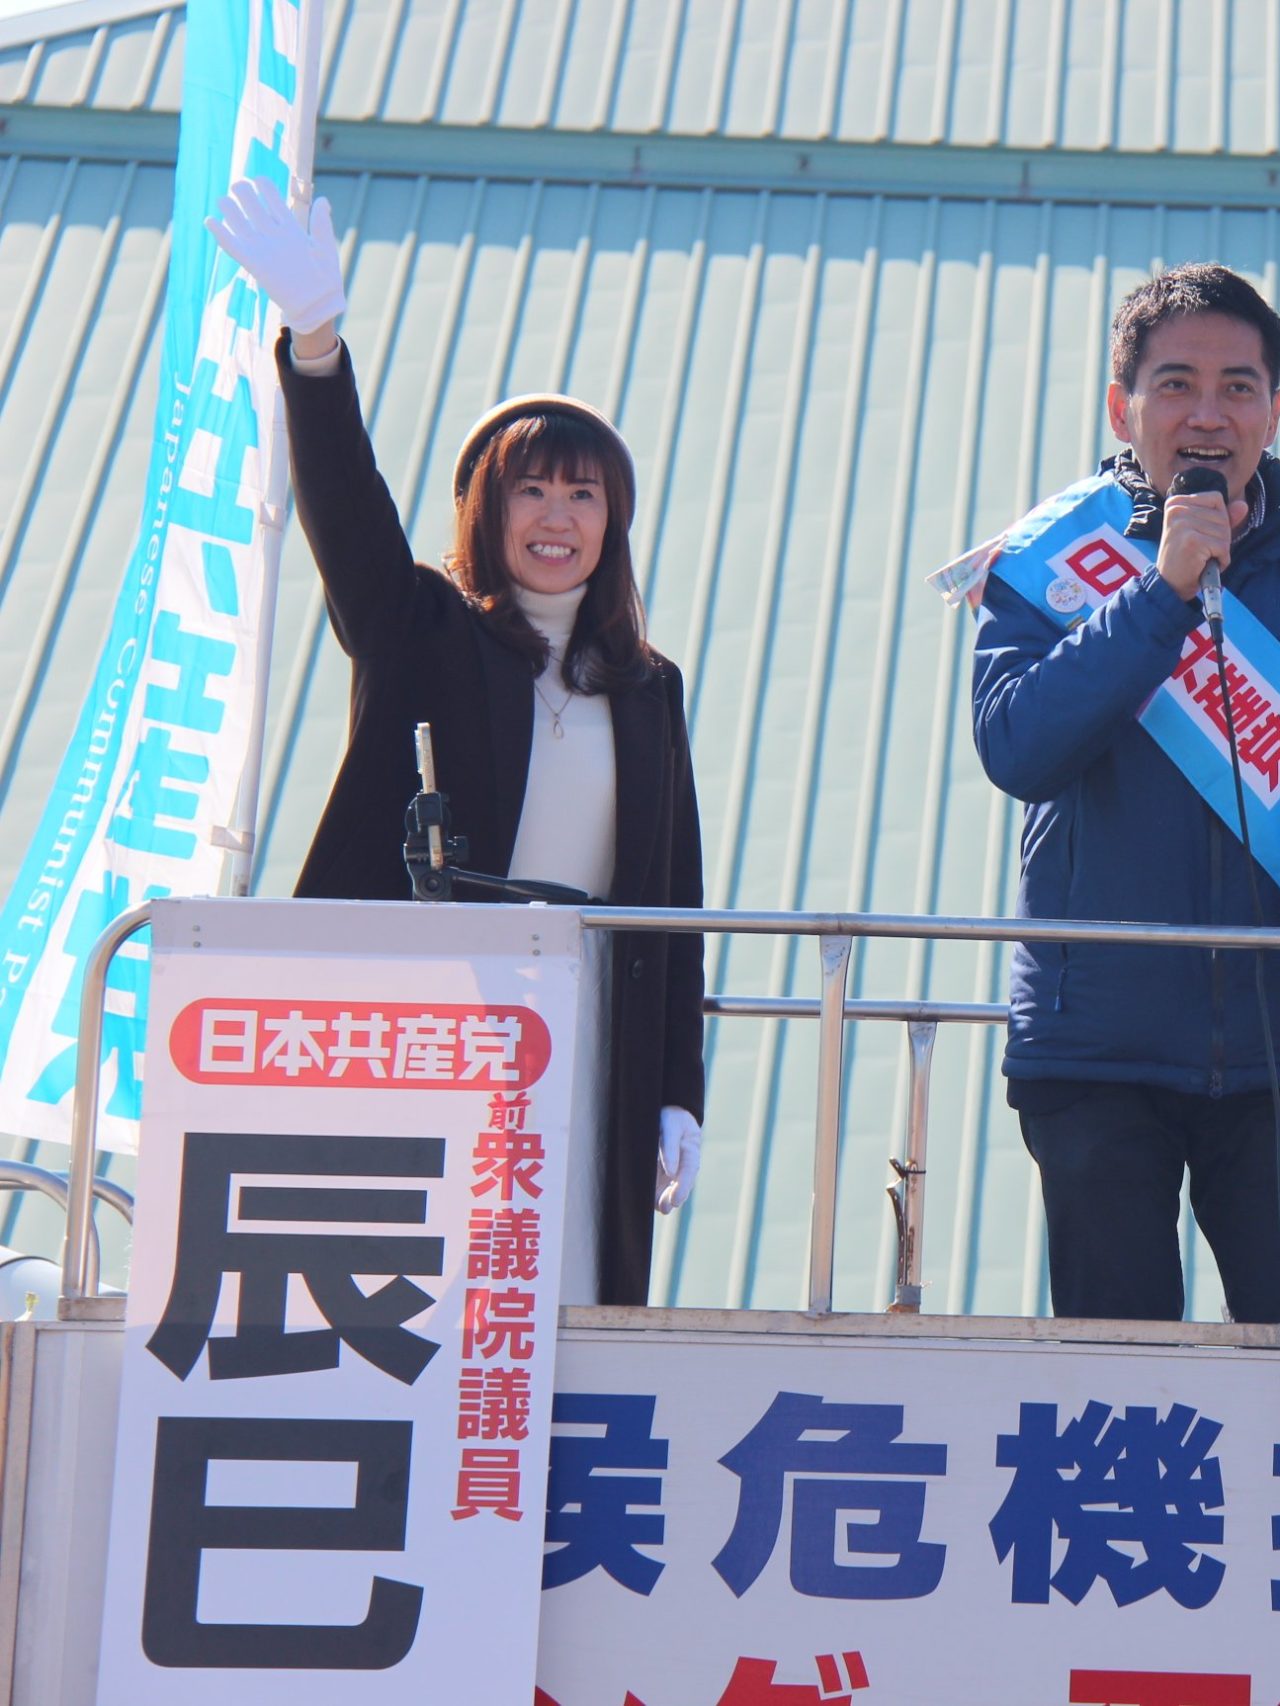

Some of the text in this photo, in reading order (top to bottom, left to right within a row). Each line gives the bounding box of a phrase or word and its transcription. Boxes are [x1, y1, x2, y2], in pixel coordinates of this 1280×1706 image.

[135, 371, 192, 616] Japanese
[17, 636, 138, 934] Communist
[199, 1009, 523, 1082] 日本共産党
[141, 1131, 446, 1671] 辰巳
